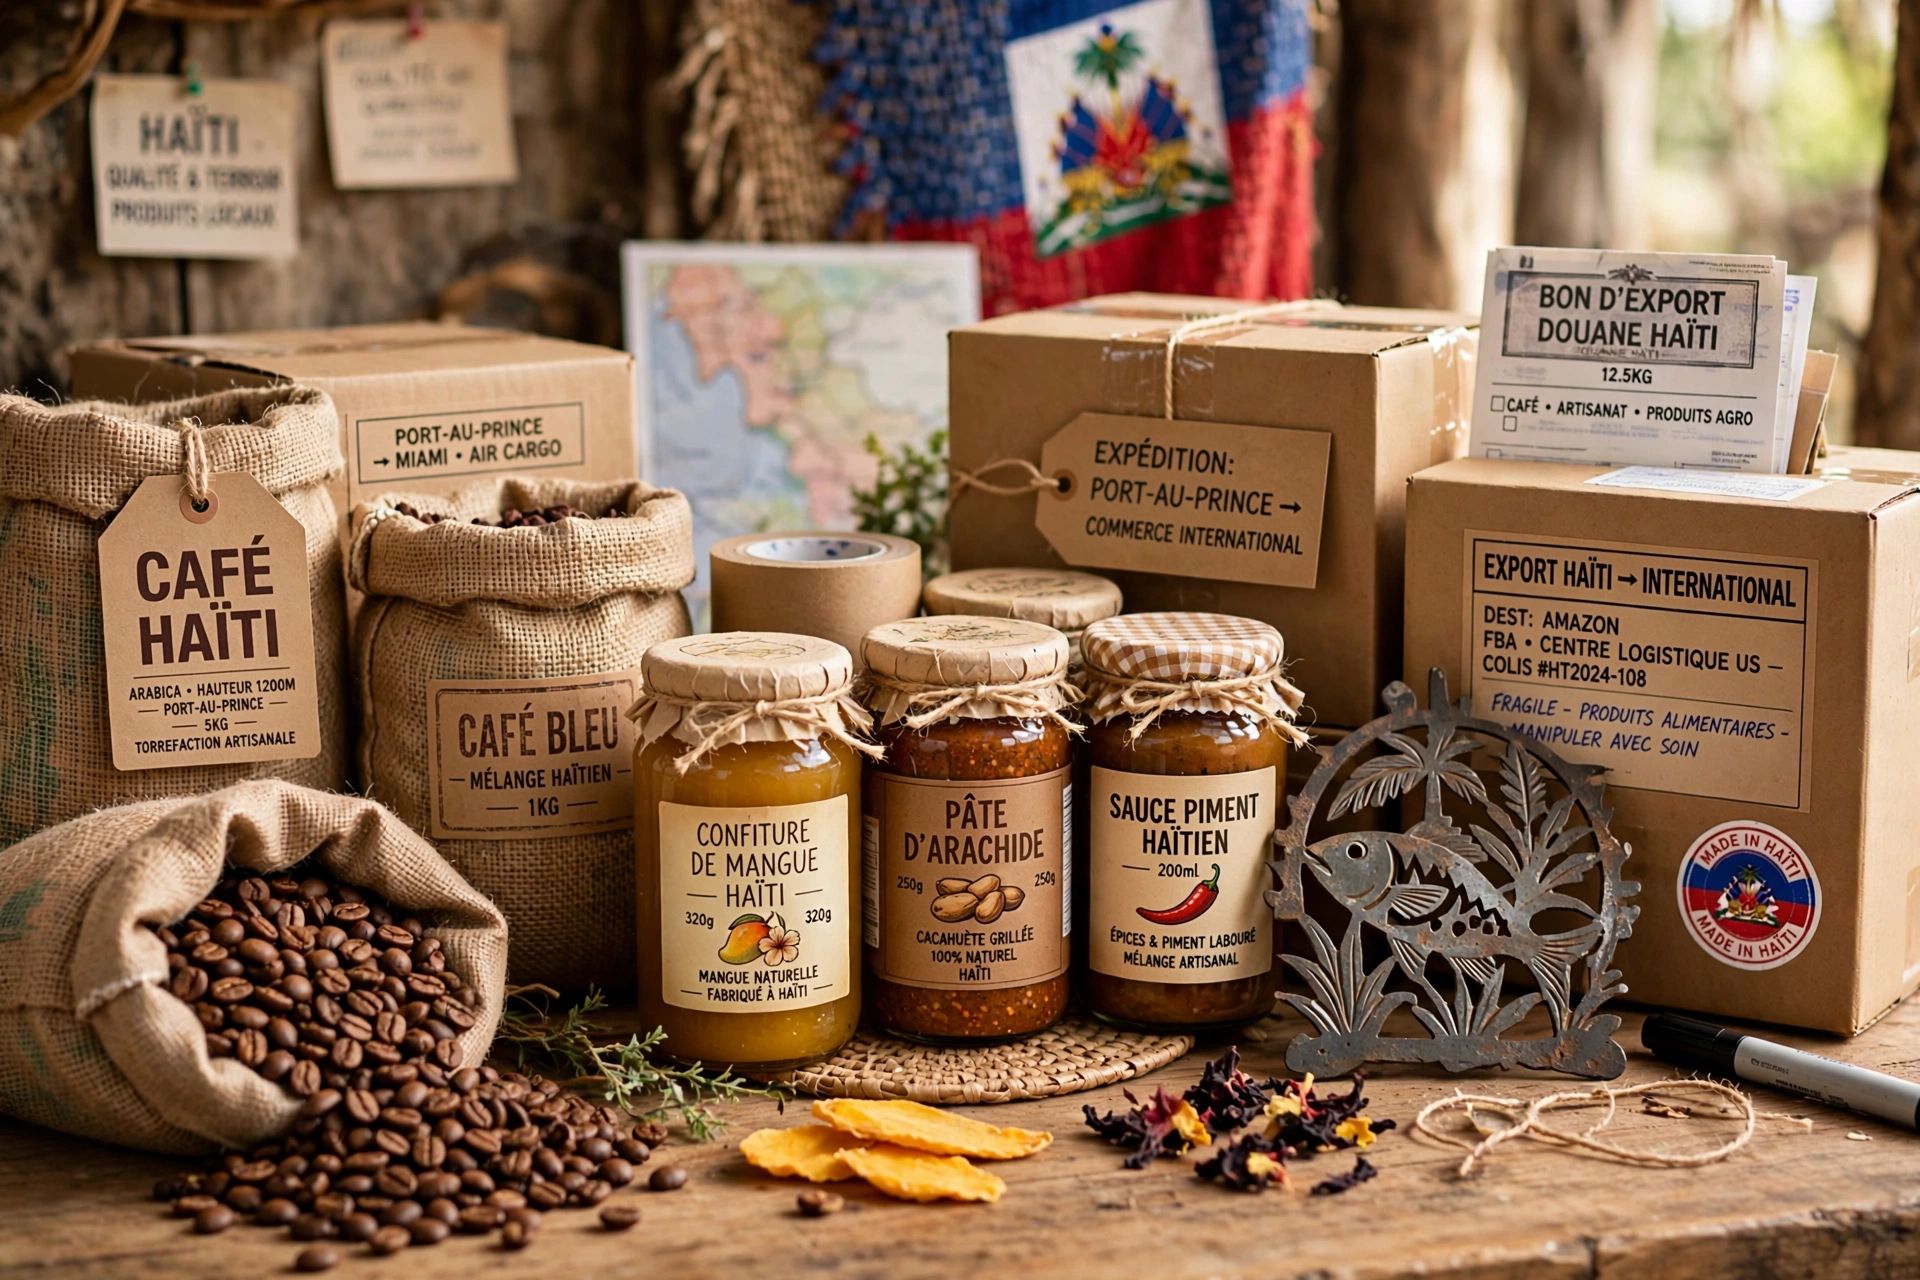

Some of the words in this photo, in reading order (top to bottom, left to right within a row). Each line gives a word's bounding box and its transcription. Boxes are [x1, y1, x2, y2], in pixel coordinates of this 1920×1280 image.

[140, 105, 240, 156] HAÏTI
[1539, 284, 1591, 311] BON
[1600, 286, 1726, 316] D’EXPORT
[1538, 318, 1642, 347] DOUANE
[1650, 318, 1718, 351] HAÏTI
[1601, 367, 1653, 385] 12.5KG
[1507, 395, 1539, 414] CAFÉ
[1556, 401, 1628, 419] ARTISANAT
[1646, 406, 1712, 424] PRODUITS
[1715, 410, 1753, 426] AGRO
[395, 418, 543, 446] PORT-AU-PRINCE
[396, 448, 448, 469] MIAMI
[469, 444, 498, 464] AIR
[503, 439, 562, 461] CARGO
[1094, 438, 1235, 475] EXPÉDITION:
[1090, 477, 1274, 516] PORT-AU-PRINCE
[1085, 516, 1174, 543] COMMERCE
[1179, 525, 1303, 555] INTERNATIONAL
[136, 534, 274, 602] CAFÉ
[1484, 553, 1558, 585] EXPORT
[1563, 556, 1613, 590] HAÏTI
[1642, 566, 1797, 608] INTERNATIONAL
[139, 601, 279, 665] HAÏTI
[1483, 605, 1534, 628] DEST:
[1542, 611, 1620, 636] AMAZON
[1483, 630, 1518, 650] FBA
[1540, 635, 1610, 659] CENTRE
[1619, 642, 1730, 671] LOGISTIQUE
[1736, 655, 1761, 674] US
[1483, 655, 1532, 676] COLIS
[1537, 660, 1647, 687] #HT2024-108
[129, 685, 182, 701] ARABICA
[197, 681, 253, 697] HAUTEUR
[256, 678, 296, 692] 1200M
[164, 697, 264, 716] PORT-AU-PRINCE
[1491, 693, 1558, 716] FRAGILE
[1580, 702, 1654, 726] PRODUITS
[1661, 712, 1776, 739] ALIMENTAIRES
[204, 718, 229, 731] 5KG
[458, 702, 536, 758] CAFÉ
[547, 706, 619, 755] BLEU
[135, 735, 221, 754] TORREFACTION
[225, 731, 296, 748] ARTISANALE
[1610, 732, 1652, 752] AVEC
[1660, 739, 1700, 758] SOIN
[470, 766, 546, 790] MÉLANGE
[552, 763, 612, 787] HAÏTIEN
[528, 797, 559, 816] 1KG
[945, 792, 1008, 830] PÂTE
[1110, 793, 1176, 824] SAUCE
[1184, 793, 1259, 824] PIMENT
[697, 818, 811, 847] CONFITURE
[904, 828, 1044, 865] D’ARACHIDE
[1142, 825, 1228, 856] HAÏTIEN
[691, 851, 717, 876] DE
[726, 847, 819, 877] MANGUE
[1700, 833, 1740, 865] MADE
[1744, 833, 1760, 847] IN
[1764, 839, 1802, 878] HAÏTI
[1034, 871, 1056, 887] 250g
[1158, 863, 1200, 878] 200ml
[726, 879, 784, 907] HAÏTI
[897, 876, 923, 895] 250g
[685, 911, 715, 930] 320g
[804, 908, 832, 924] 320g
[916, 929, 986, 946] CACAHUÈTE
[989, 925, 1034, 944] GRILLÉE
[1110, 926, 1146, 947] ÉPICES
[1149, 935, 1158, 948] &
[1162, 935, 1206, 949] PIMENT
[1209, 927, 1256, 949] LABOURÉ
[1697, 915, 1735, 952] MADE
[1738, 944, 1753, 958] IN
[1759, 928, 1797, 957] HAÏTI
[931, 950, 962, 963] 100%
[966, 948, 1018, 964] NATUREL
[1123, 950, 1175, 968] MÉLANGE
[1179, 952, 1239, 969] ARTISANAL
[699, 969, 750, 984] MANGUE
[754, 964, 819, 984] NATURELLE
[959, 964, 991, 981] HAÏTI
[707, 985, 763, 1003] FABRIQUÉ
[766, 984, 775, 1001] À
[779, 983, 808, 1000] HAÏTI
